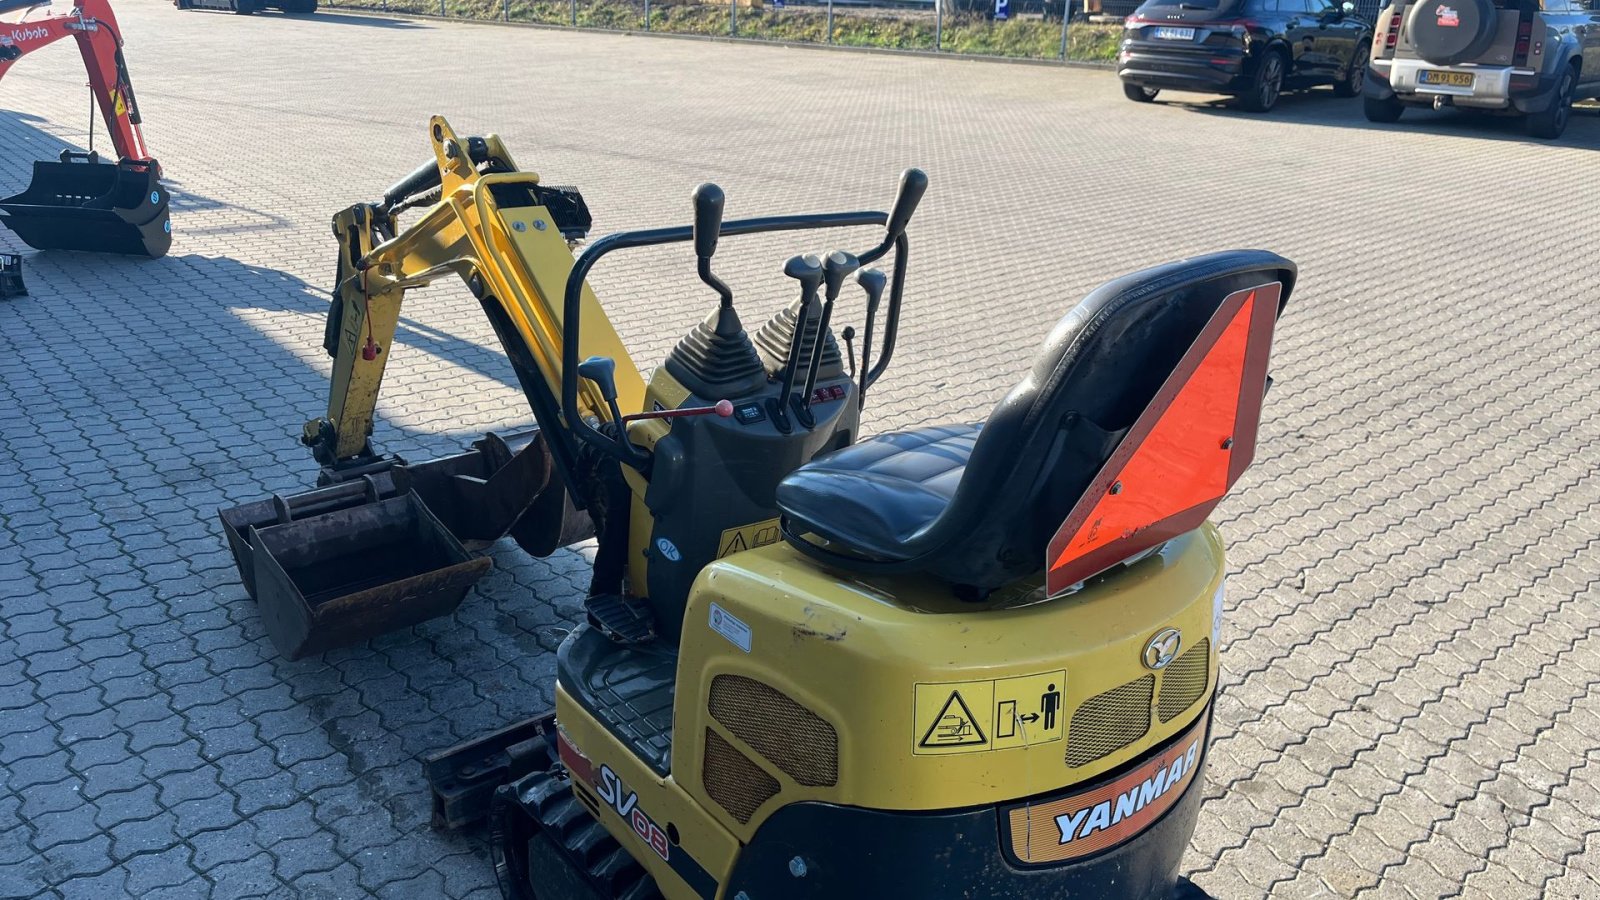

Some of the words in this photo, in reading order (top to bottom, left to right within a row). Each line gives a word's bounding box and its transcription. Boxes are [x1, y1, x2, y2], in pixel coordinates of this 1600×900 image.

[995, 0, 1008, 13] P
[11, 26, 48, 41] Kubota
[1427, 73, 1440, 81] DM
[1453, 75, 1470, 84] 956
[660, 540, 676, 559] OK
[1054, 738, 1199, 845] YANMAR
